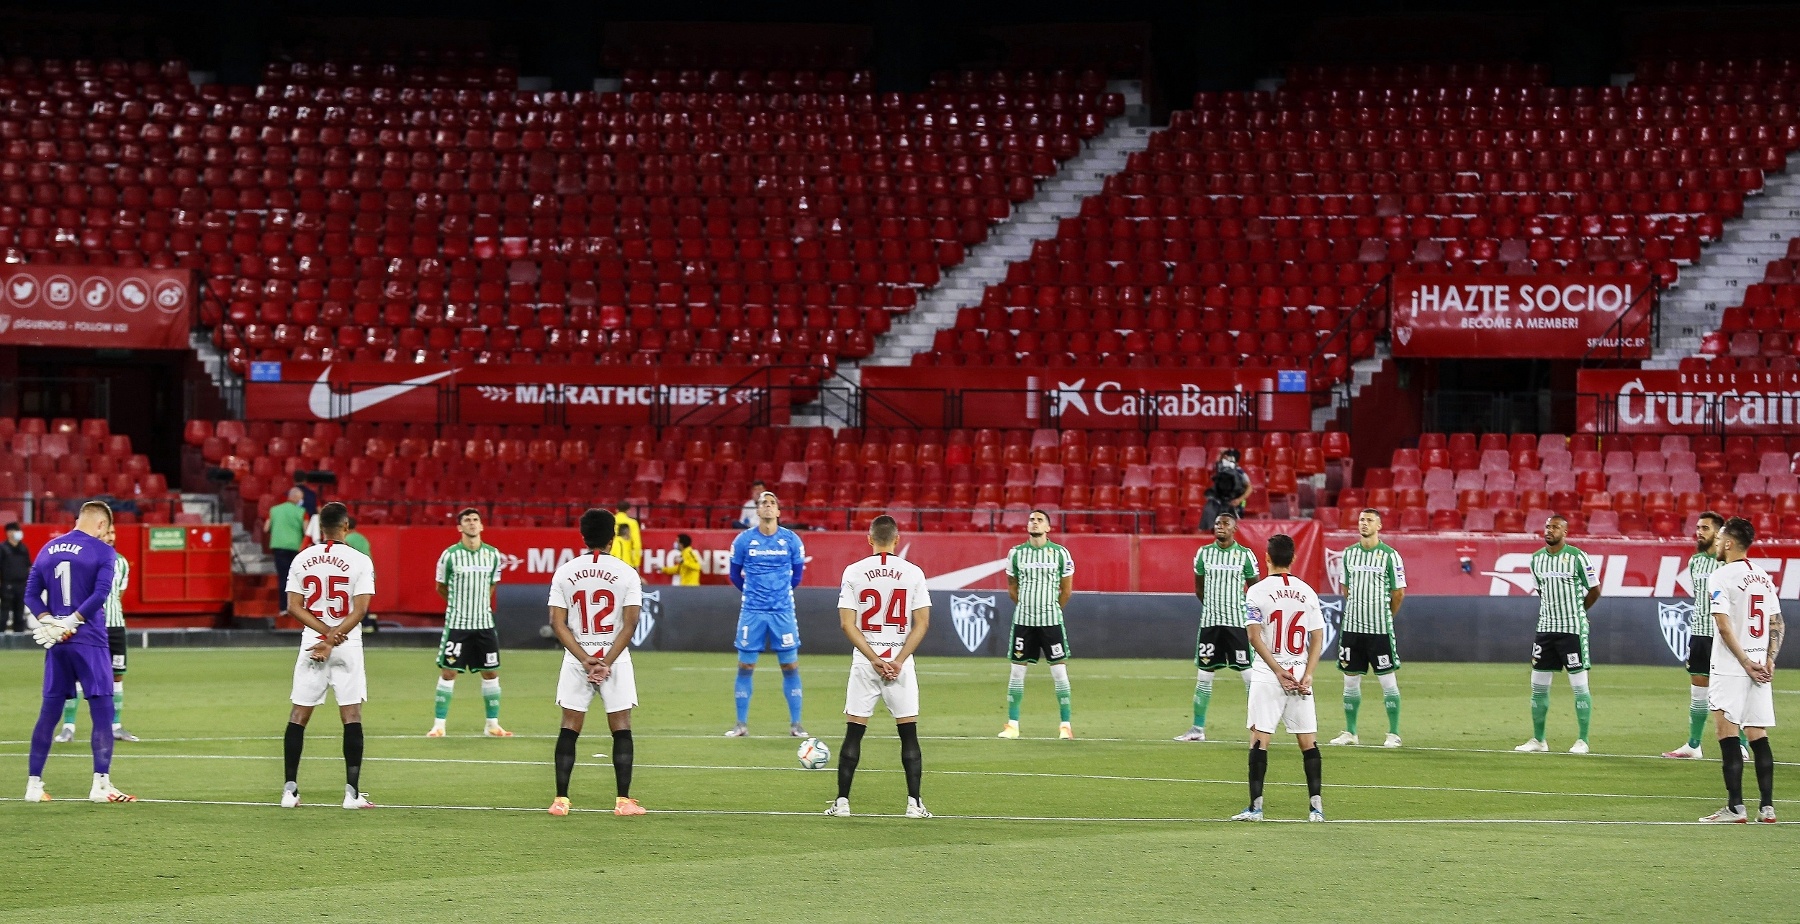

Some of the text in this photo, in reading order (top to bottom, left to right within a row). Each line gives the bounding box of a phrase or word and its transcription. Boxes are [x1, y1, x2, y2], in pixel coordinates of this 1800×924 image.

[1411, 284, 1631, 317] ¡HAZTE SOCIO!
[74, 321, 112, 332] FOLLOW
[113, 323, 129, 333] US!
[1461, 317, 1578, 329] BECOME A MEMBER!
[1680, 373, 1736, 384] DESDE
[515, 382, 731, 405] MARATHONBET
[1094, 381, 1253, 417] CaixaBank
[48, 543, 83, 555] VACLIK
[302, 555, 350, 572] FERNANDO
[567, 569, 619, 586] J.KOUNDÉ
[864, 568, 903, 582] JORDÁN
[54, 561, 71, 607] 1
[303, 575, 350, 620] 25
[1269, 589, 1307, 604] J.NAVAS
[571, 588, 615, 635] 12
[858, 588, 907, 634] 24
[1749, 594, 1764, 639] 5
[742, 626, 749, 640] 1
[1267, 609, 1306, 656] 16
[445, 641, 462, 657] 24
[1015, 637, 1024, 651] 5
[1199, 643, 1215, 657] 22
[1339, 646, 1351, 661] 21
